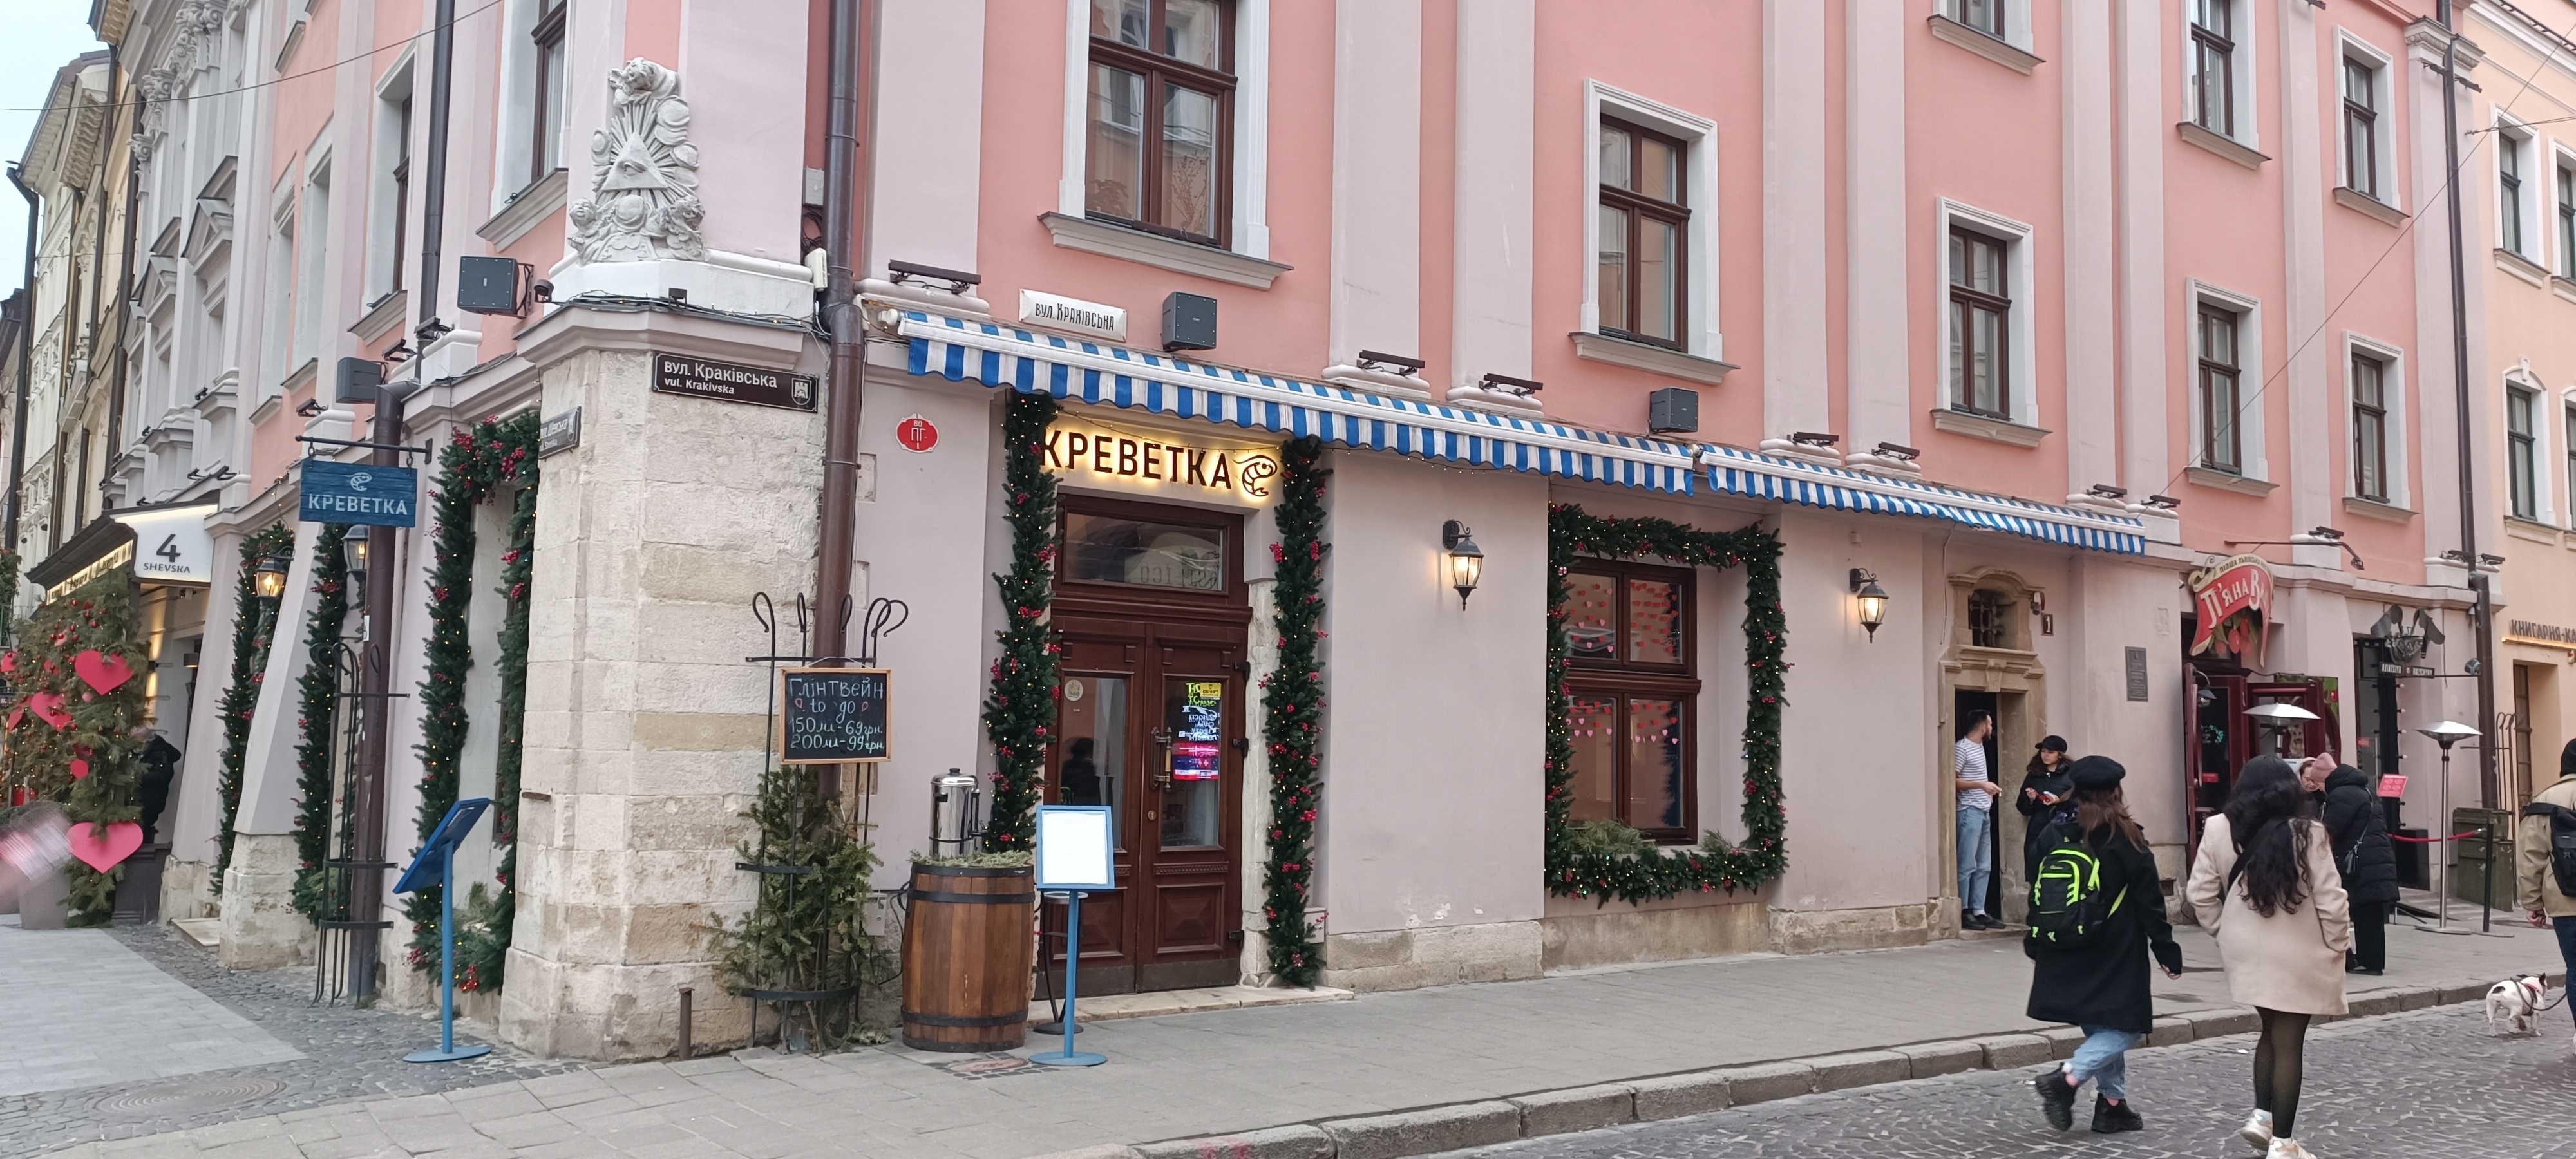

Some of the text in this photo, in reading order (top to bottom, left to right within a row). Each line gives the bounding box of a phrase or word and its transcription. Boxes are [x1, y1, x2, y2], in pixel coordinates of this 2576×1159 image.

[664, 361, 778, 388] вул. Краківська
[664, 378, 735, 395] vul. Krakivska
[1042, 430, 1232, 489] КРЕВЕТКА
[308, 494, 408, 515] КРЕВЕТКА
[156, 534, 182, 563] 4
[143, 562, 191, 574] SHEVSKA
[2046, 616, 2051, 633] 1
[810, 699, 855, 724] to go
